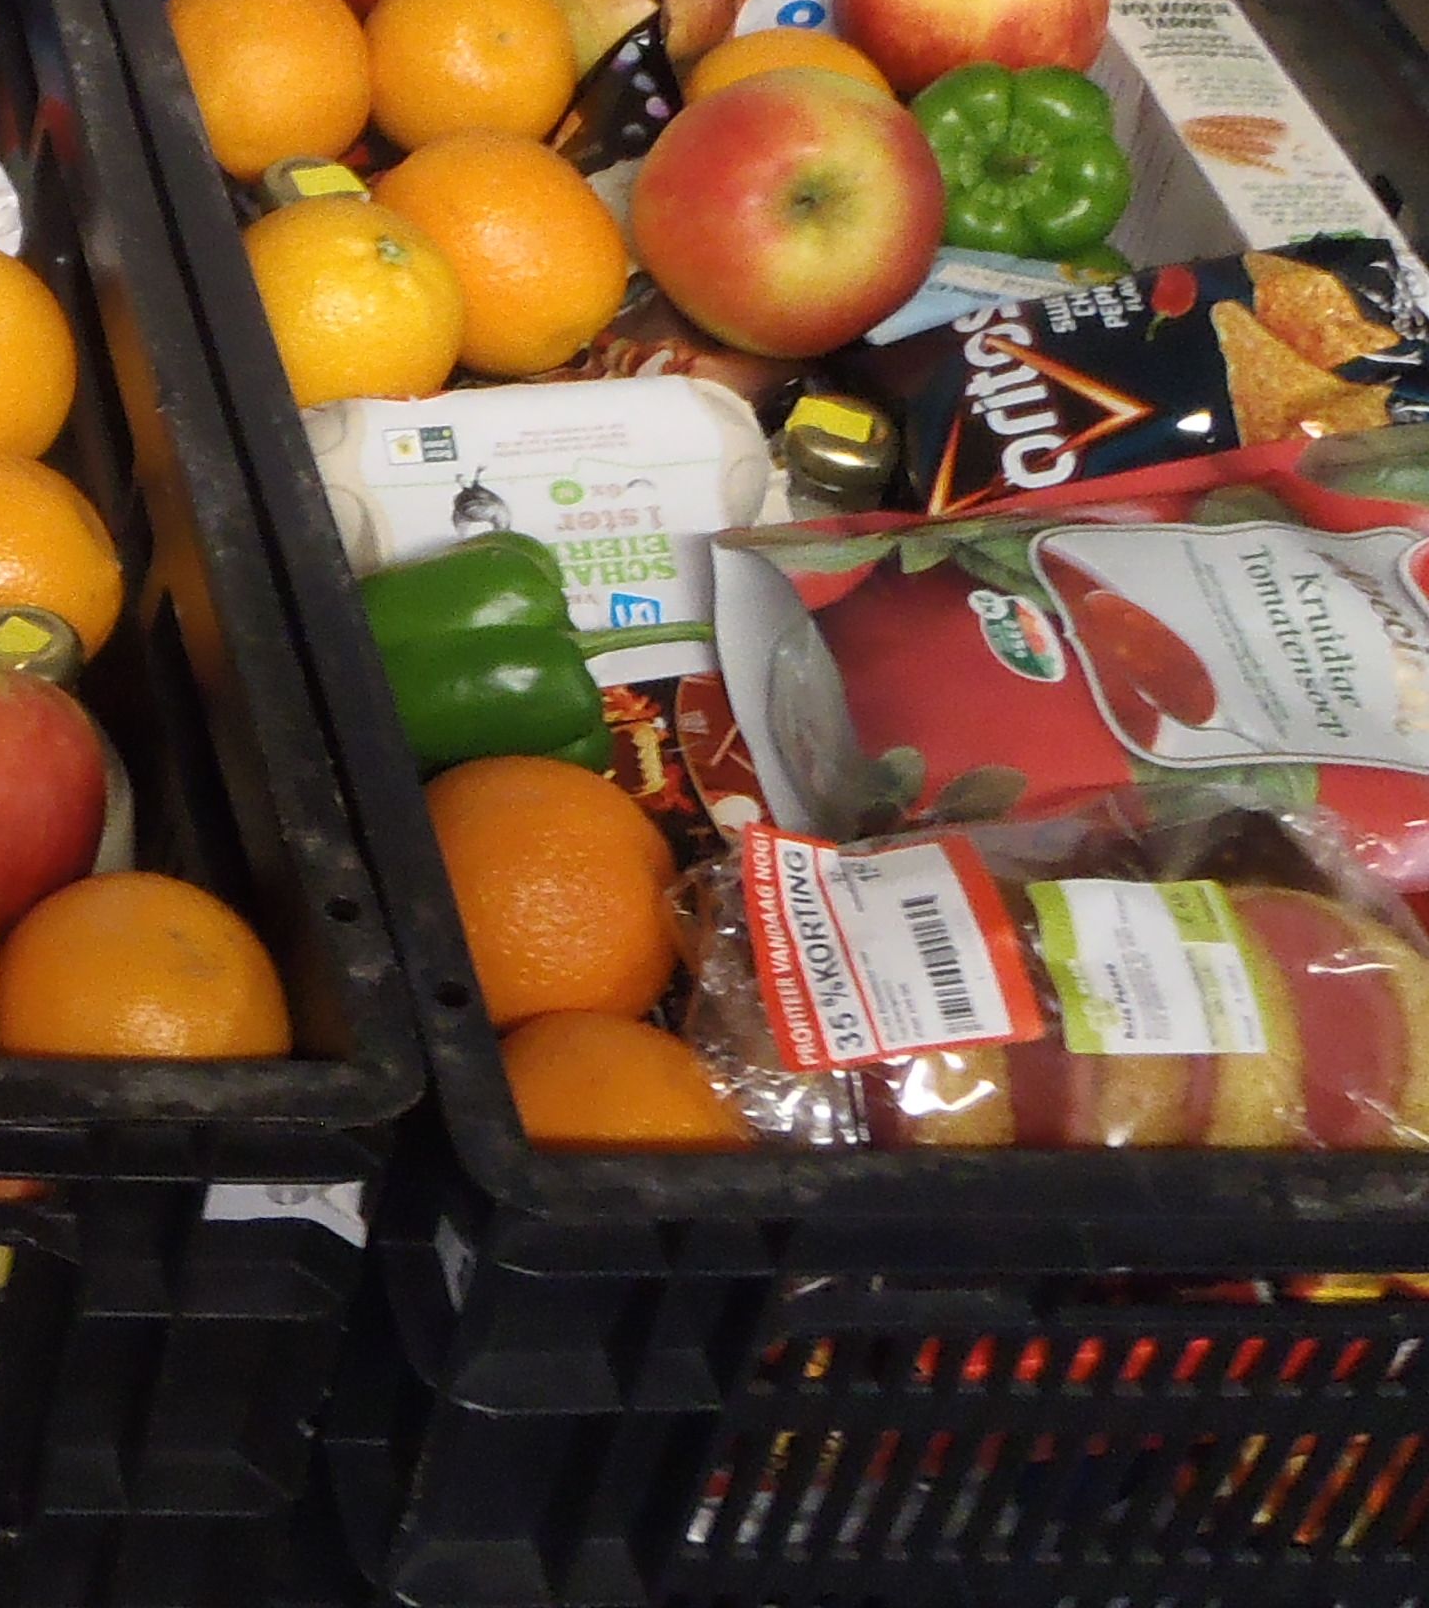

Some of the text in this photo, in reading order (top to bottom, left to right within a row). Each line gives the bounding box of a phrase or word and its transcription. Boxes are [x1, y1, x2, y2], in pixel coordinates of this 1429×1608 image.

[953, 301, 1077, 489] oritos
[1240, 543, 1350, 738] Tomatensoep
[754, 882, 793, 976] VANDAAG
[827, 1011, 864, 1052] 35
